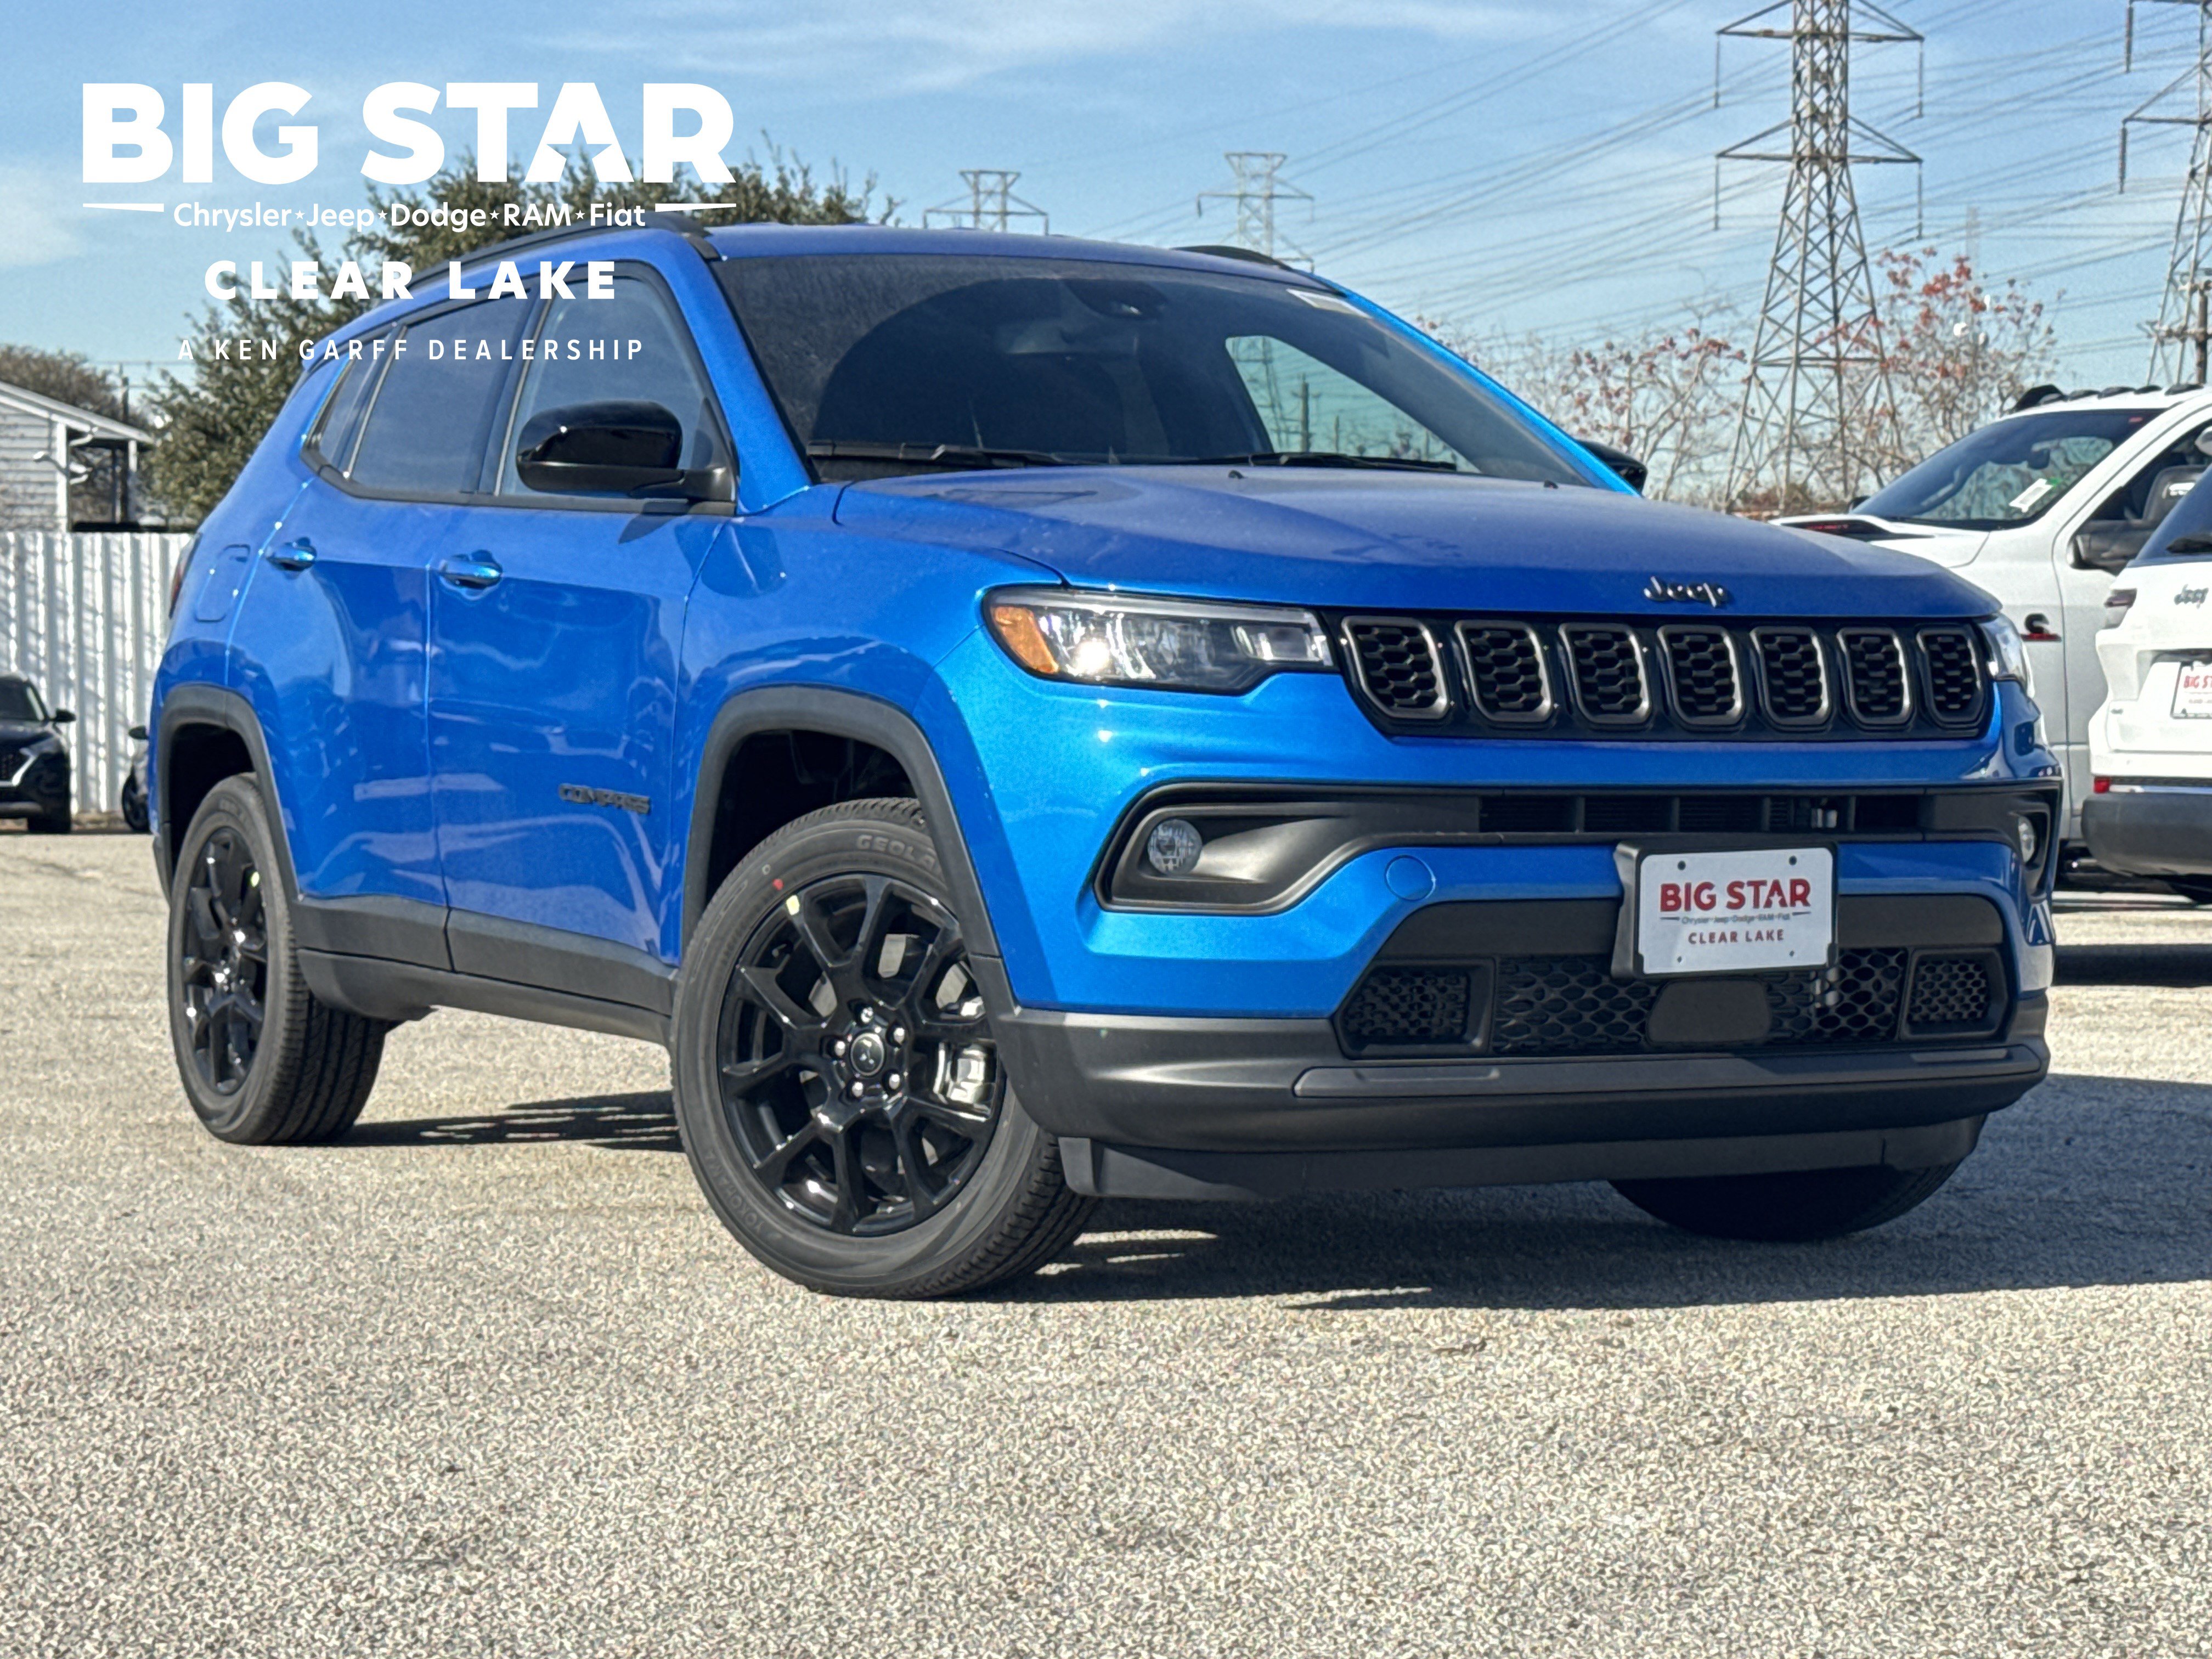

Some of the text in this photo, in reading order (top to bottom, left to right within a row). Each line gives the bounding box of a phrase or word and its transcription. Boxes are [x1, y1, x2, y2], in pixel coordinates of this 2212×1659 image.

[1644, 575, 1728, 608] Jeep
[1660, 878, 1811, 912] BIG STAR
[1688, 929, 1784, 945] CLEAR LAKE
